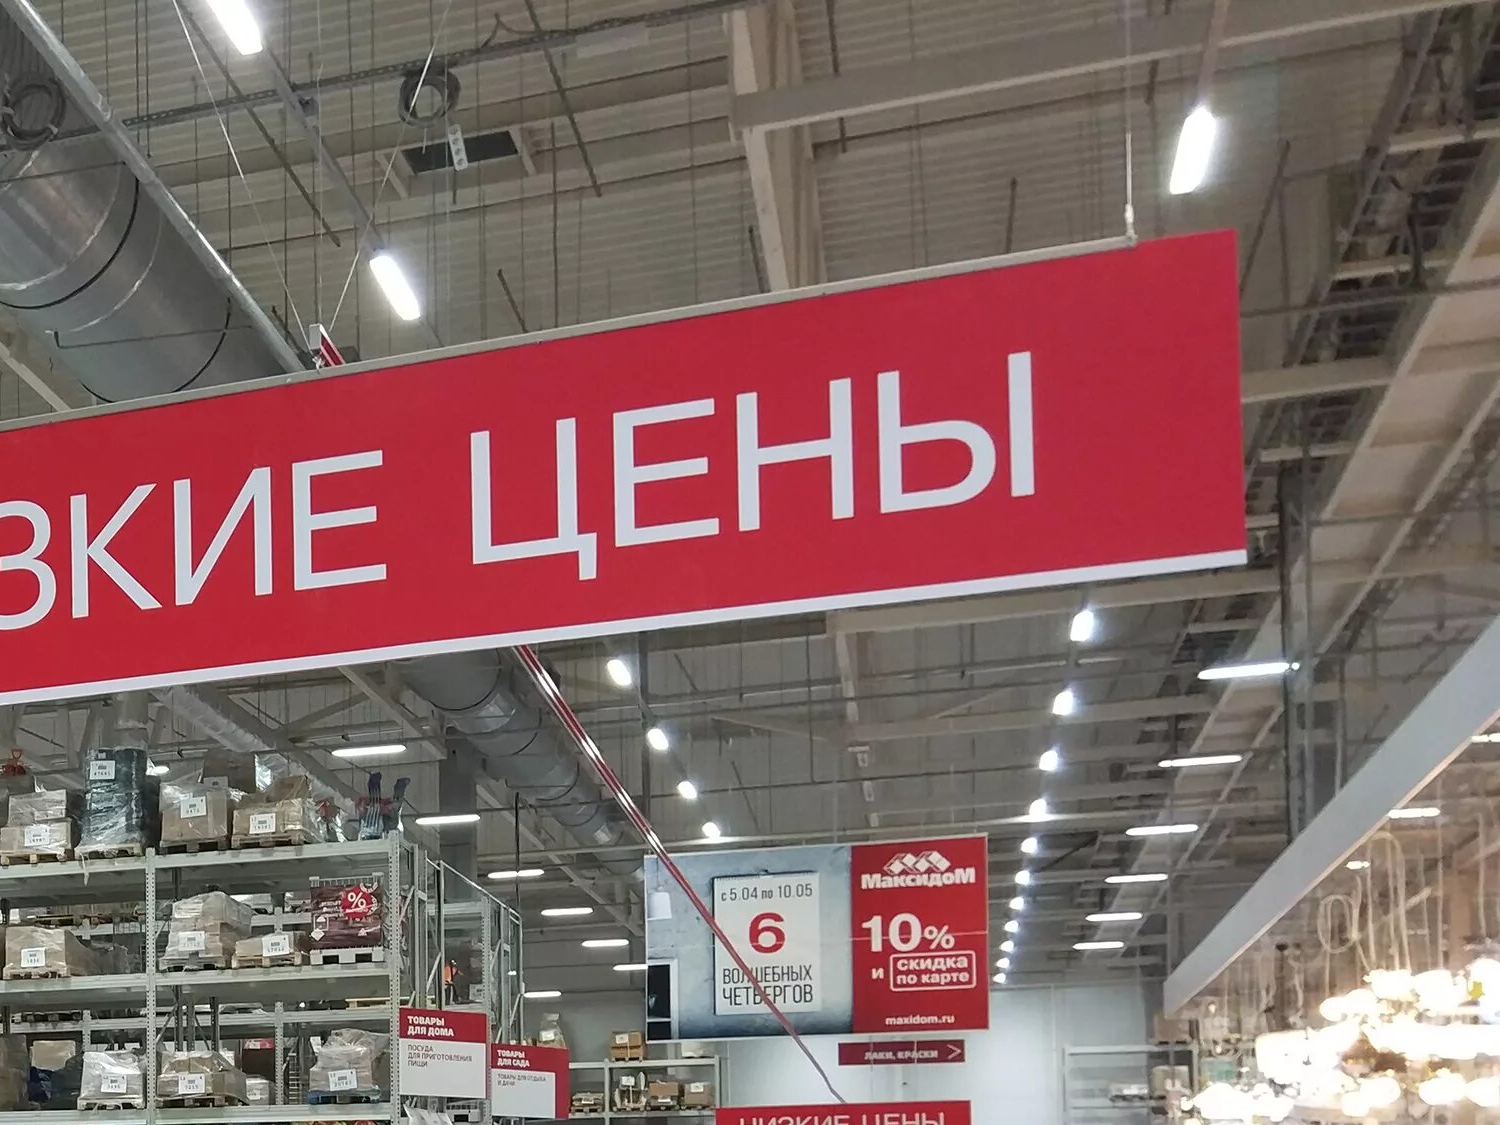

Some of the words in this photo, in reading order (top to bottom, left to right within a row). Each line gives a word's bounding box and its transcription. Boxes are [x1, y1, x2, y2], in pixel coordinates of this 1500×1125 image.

[467, 350, 1037, 580] ЦЕНЫ
[730, 887, 758, 901] 5.04
[761, 889, 773, 899] по
[778, 883, 812, 898] 10.05
[749, 911, 786, 954] 6
[862, 912, 955, 952] 10%
[896, 955, 968, 972] скидка
[871, 967, 884, 980] и
[896, 974, 917, 985] по
[921, 971, 970, 986] карте
[408, 1016, 445, 1027] ТОВАРЫ
[885, 1014, 955, 1026] maxidom.ru
[408, 1027, 427, 1036] ДЛЯ
[428, 1028, 455, 1038] ДОМА
[408, 1045, 433, 1053] ПОСУДА
[497, 1050, 525, 1059] ТОВАРЫ
[408, 1053, 420, 1061] ДЛЯ
[422, 1053, 473, 1063] ПРИГОТОВЛЕНИЯ
[497, 1058, 512, 1067] ДЛЯ
[513, 1059, 530, 1068] САДА
